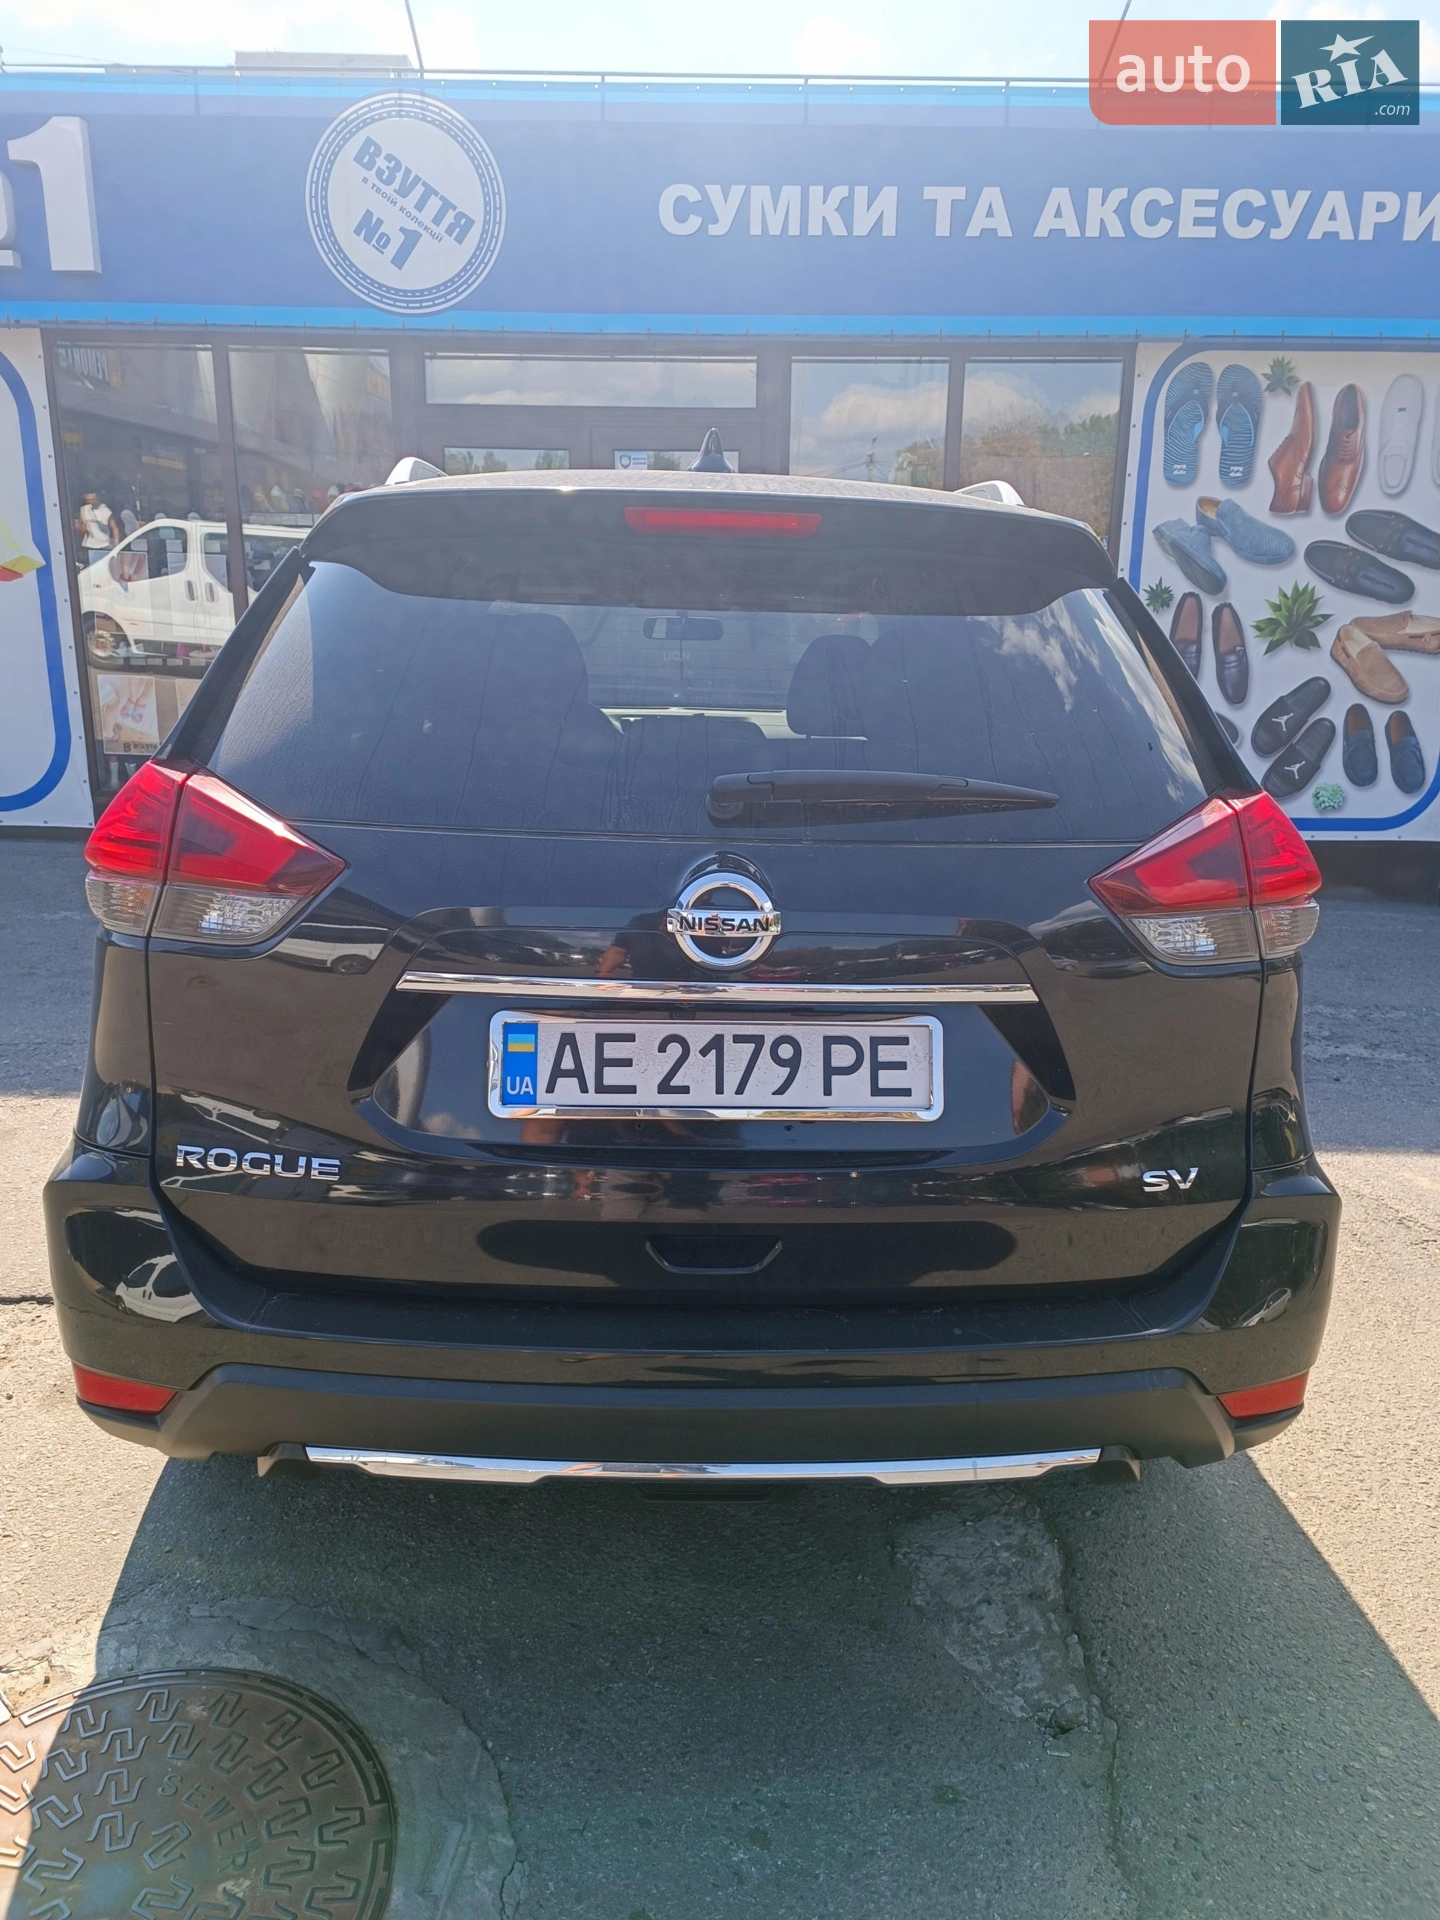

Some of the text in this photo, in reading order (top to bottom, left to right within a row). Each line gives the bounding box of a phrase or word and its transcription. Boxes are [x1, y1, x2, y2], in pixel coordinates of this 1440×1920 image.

[353, 135, 476, 246] ВЗУТТЯ
[370, 182, 399, 208] твоїй
[398, 205, 446, 244] колекції
[658, 183, 1440, 242] СУМКИ ТА АКСЕСУАРИ
[680, 915, 770, 932] NISSAN
[506, 1076, 534, 1096] UA
[545, 1032, 912, 1097] AE 2179 PE
[176, 1144, 341, 1181] ROGUE
[1142, 1167, 1199, 1192] SV
[157, 1773, 250, 1874] SEWER
